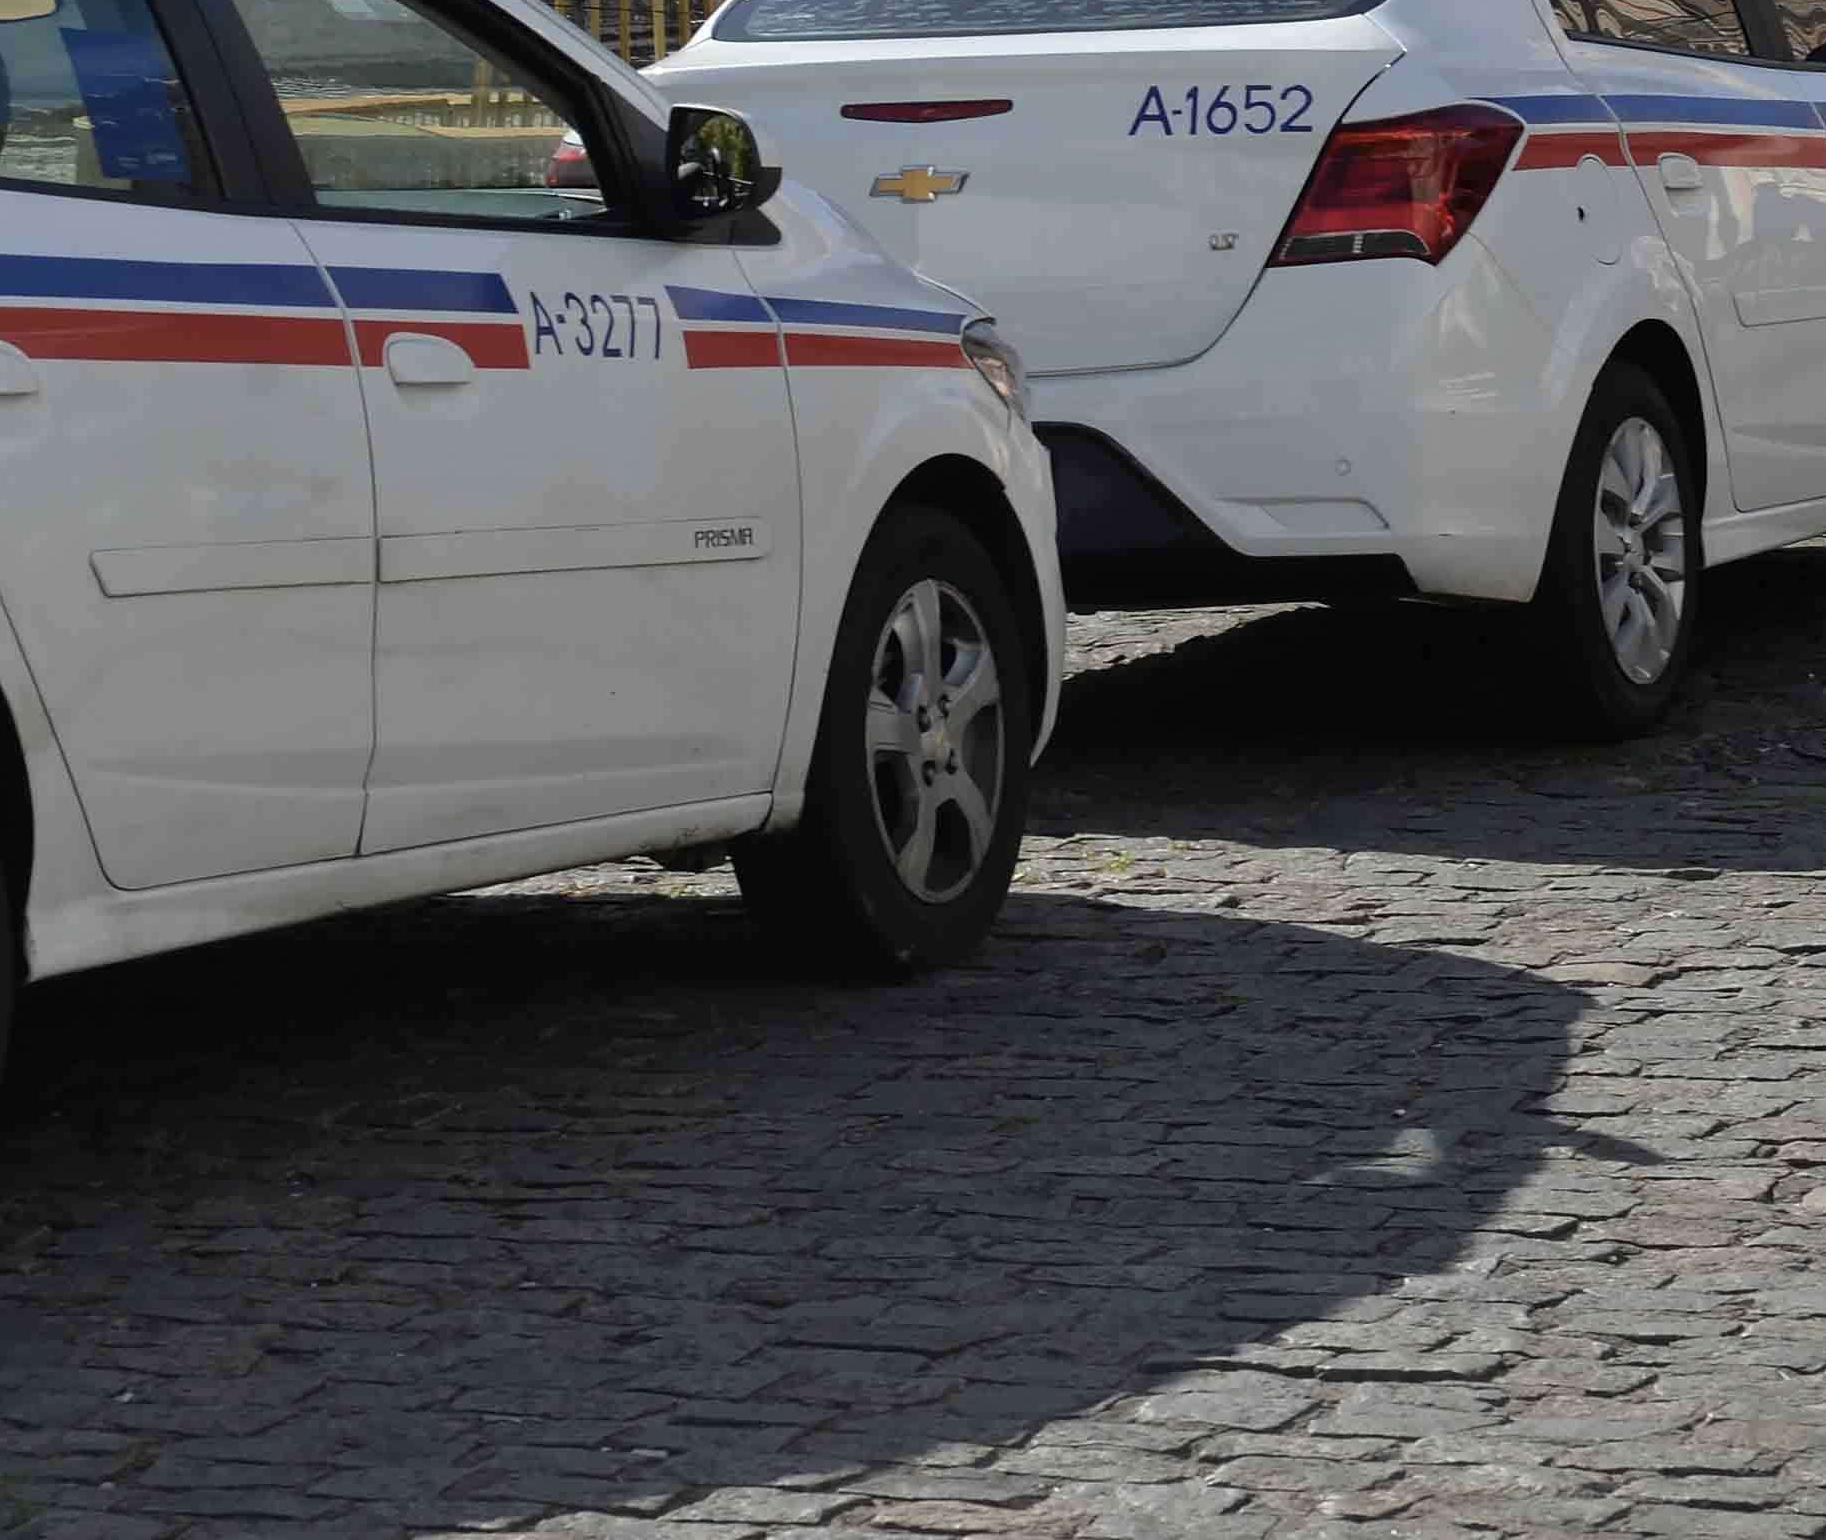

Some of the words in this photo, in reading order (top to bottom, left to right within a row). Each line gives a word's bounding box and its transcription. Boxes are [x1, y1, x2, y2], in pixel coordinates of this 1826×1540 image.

[1127, 84, 1313, 136] A-1652
[530, 291, 661, 360] A-3277
[693, 527, 755, 549] PRISMA
